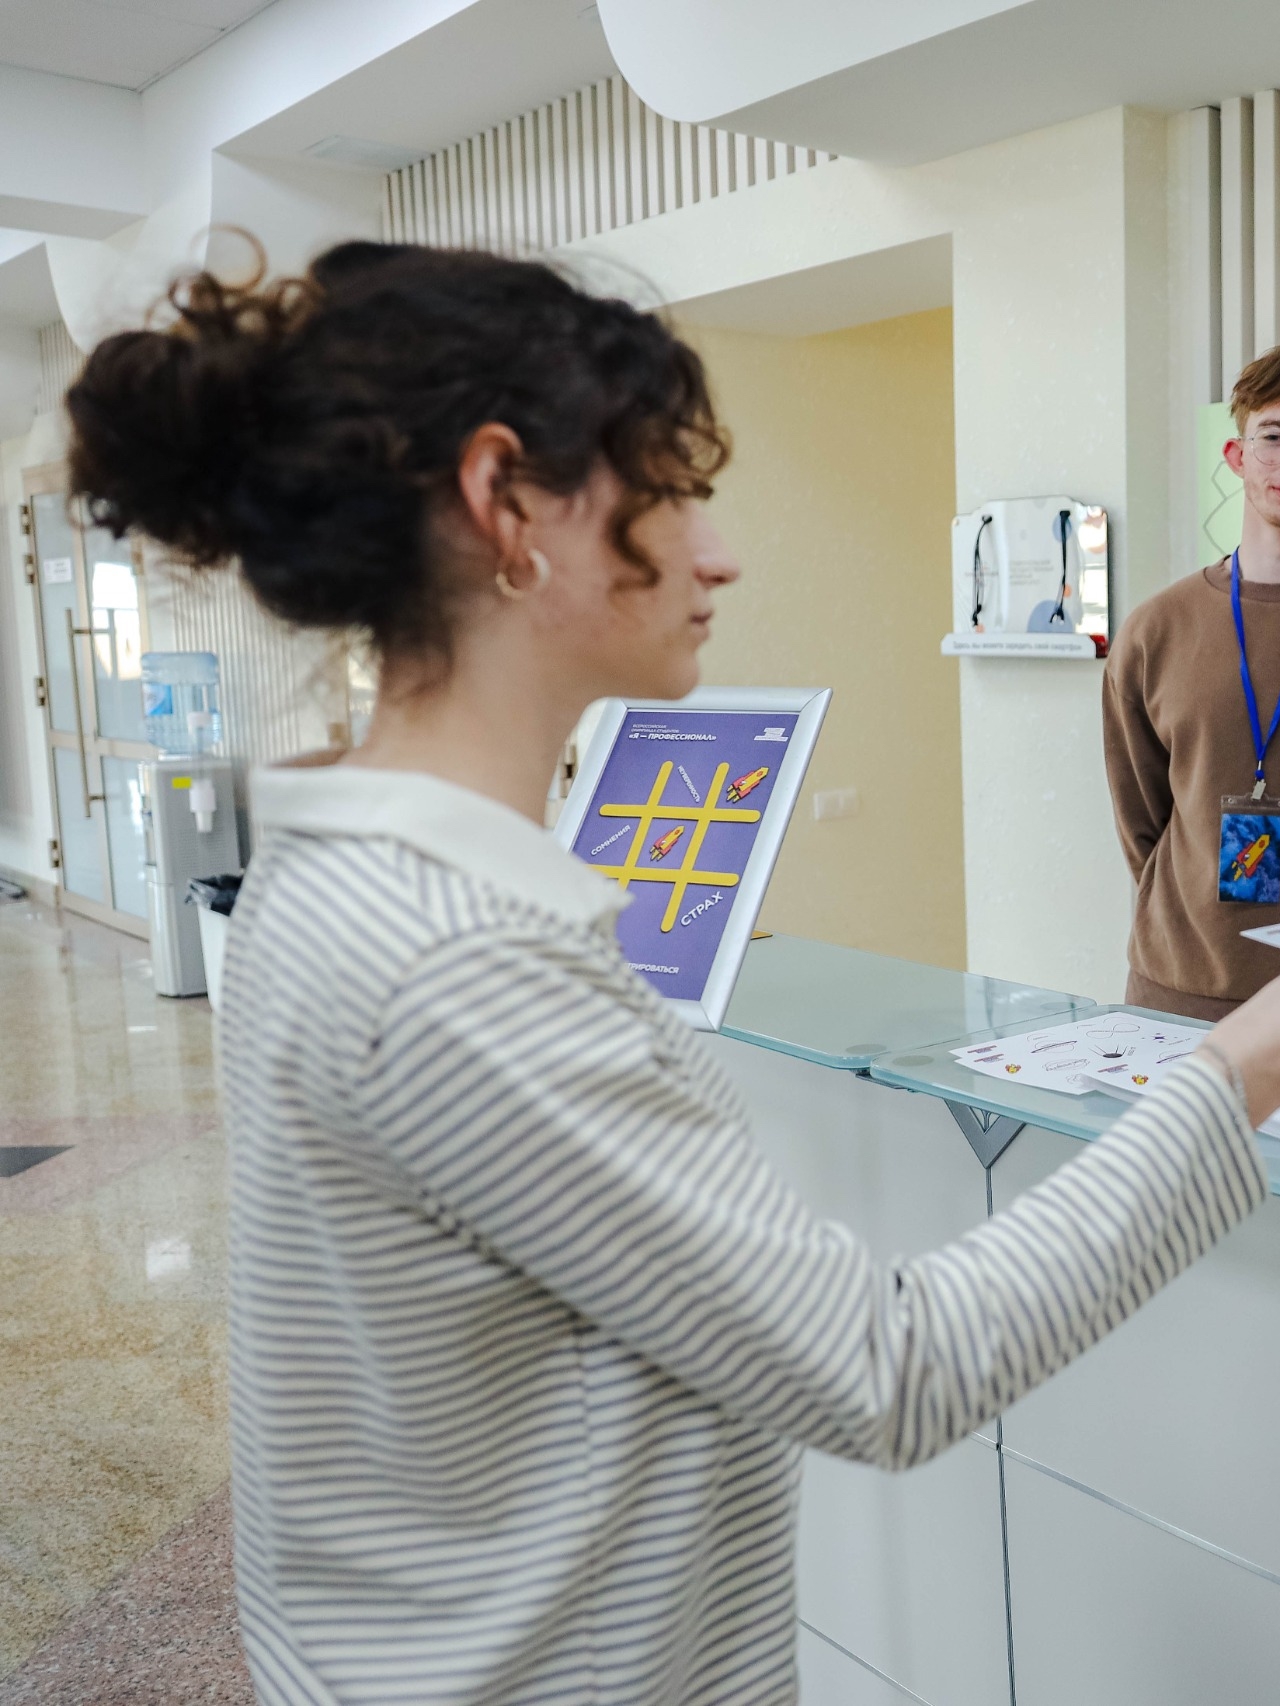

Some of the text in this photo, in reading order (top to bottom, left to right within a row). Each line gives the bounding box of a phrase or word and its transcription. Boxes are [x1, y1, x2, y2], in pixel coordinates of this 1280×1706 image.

[647, 733, 717, 741] ПРОФЕССИОНАЛ»
[591, 824, 631, 856] СОМНЕНИЯ
[680, 890, 724, 926] СТРАХ
[624, 962, 680, 974] ТРИРОВАТЬСЯ
